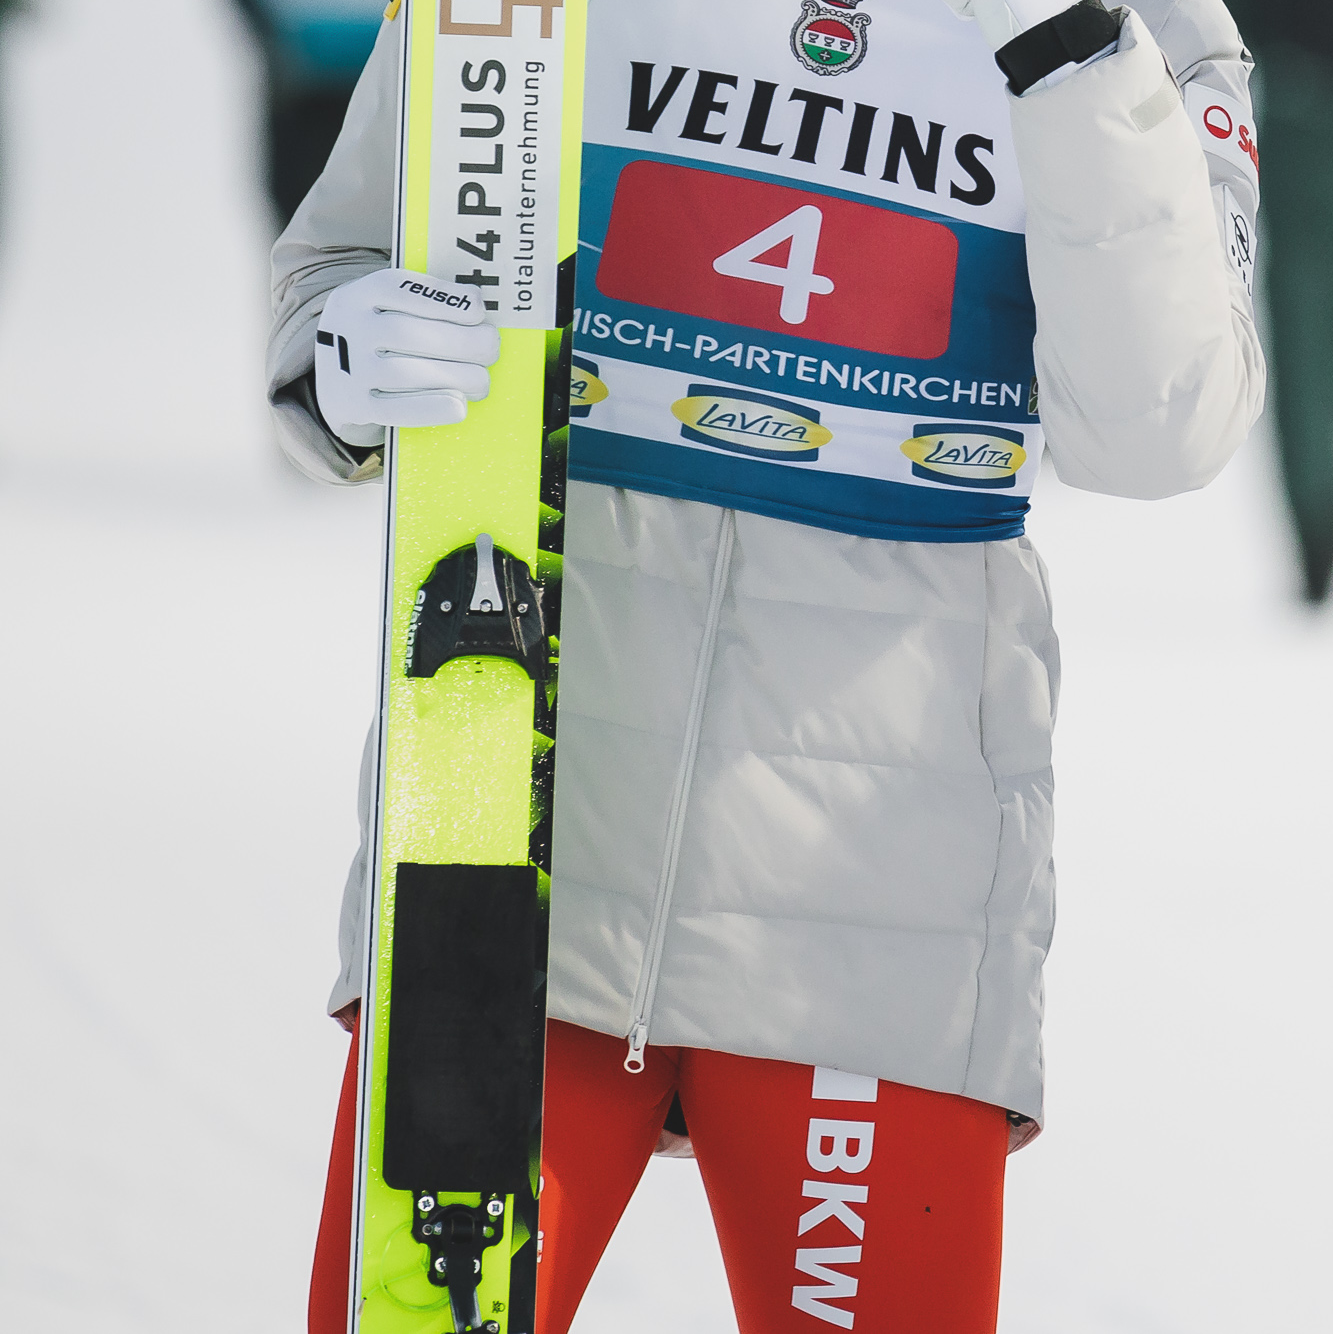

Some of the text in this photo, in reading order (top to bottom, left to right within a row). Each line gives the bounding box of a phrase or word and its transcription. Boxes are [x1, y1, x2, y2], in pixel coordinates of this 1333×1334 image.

[513, 60, 545, 312] totalunternehmung
[626, 61, 996, 206] VELTINS
[399, 279, 472, 311] reusch
[712, 204, 835, 325] 4
[790, 1118, 876, 1331] BKW
